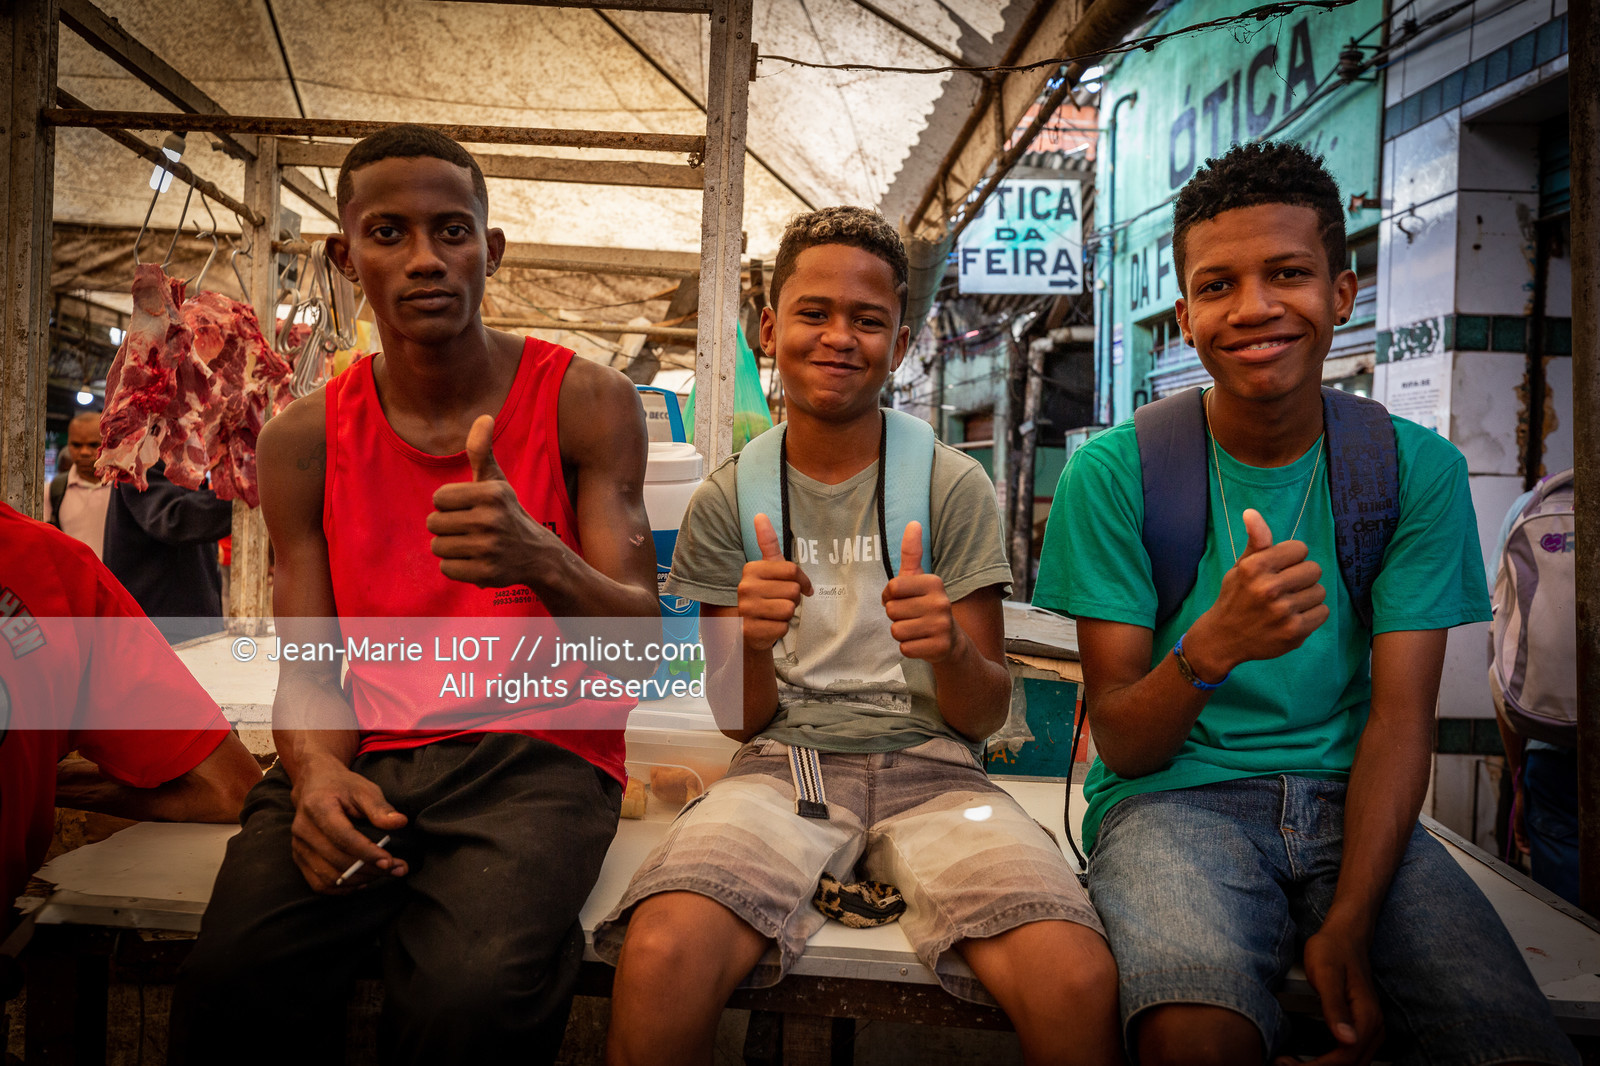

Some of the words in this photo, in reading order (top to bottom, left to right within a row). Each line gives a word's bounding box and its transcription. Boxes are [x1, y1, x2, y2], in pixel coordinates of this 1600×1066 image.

[1169, 16, 1318, 190] ÓTICA
[995, 228, 1045, 241] DA
[962, 248, 1078, 275] FEIRA
[1131, 247, 1150, 311] DA
[797, 537, 819, 564] DE
